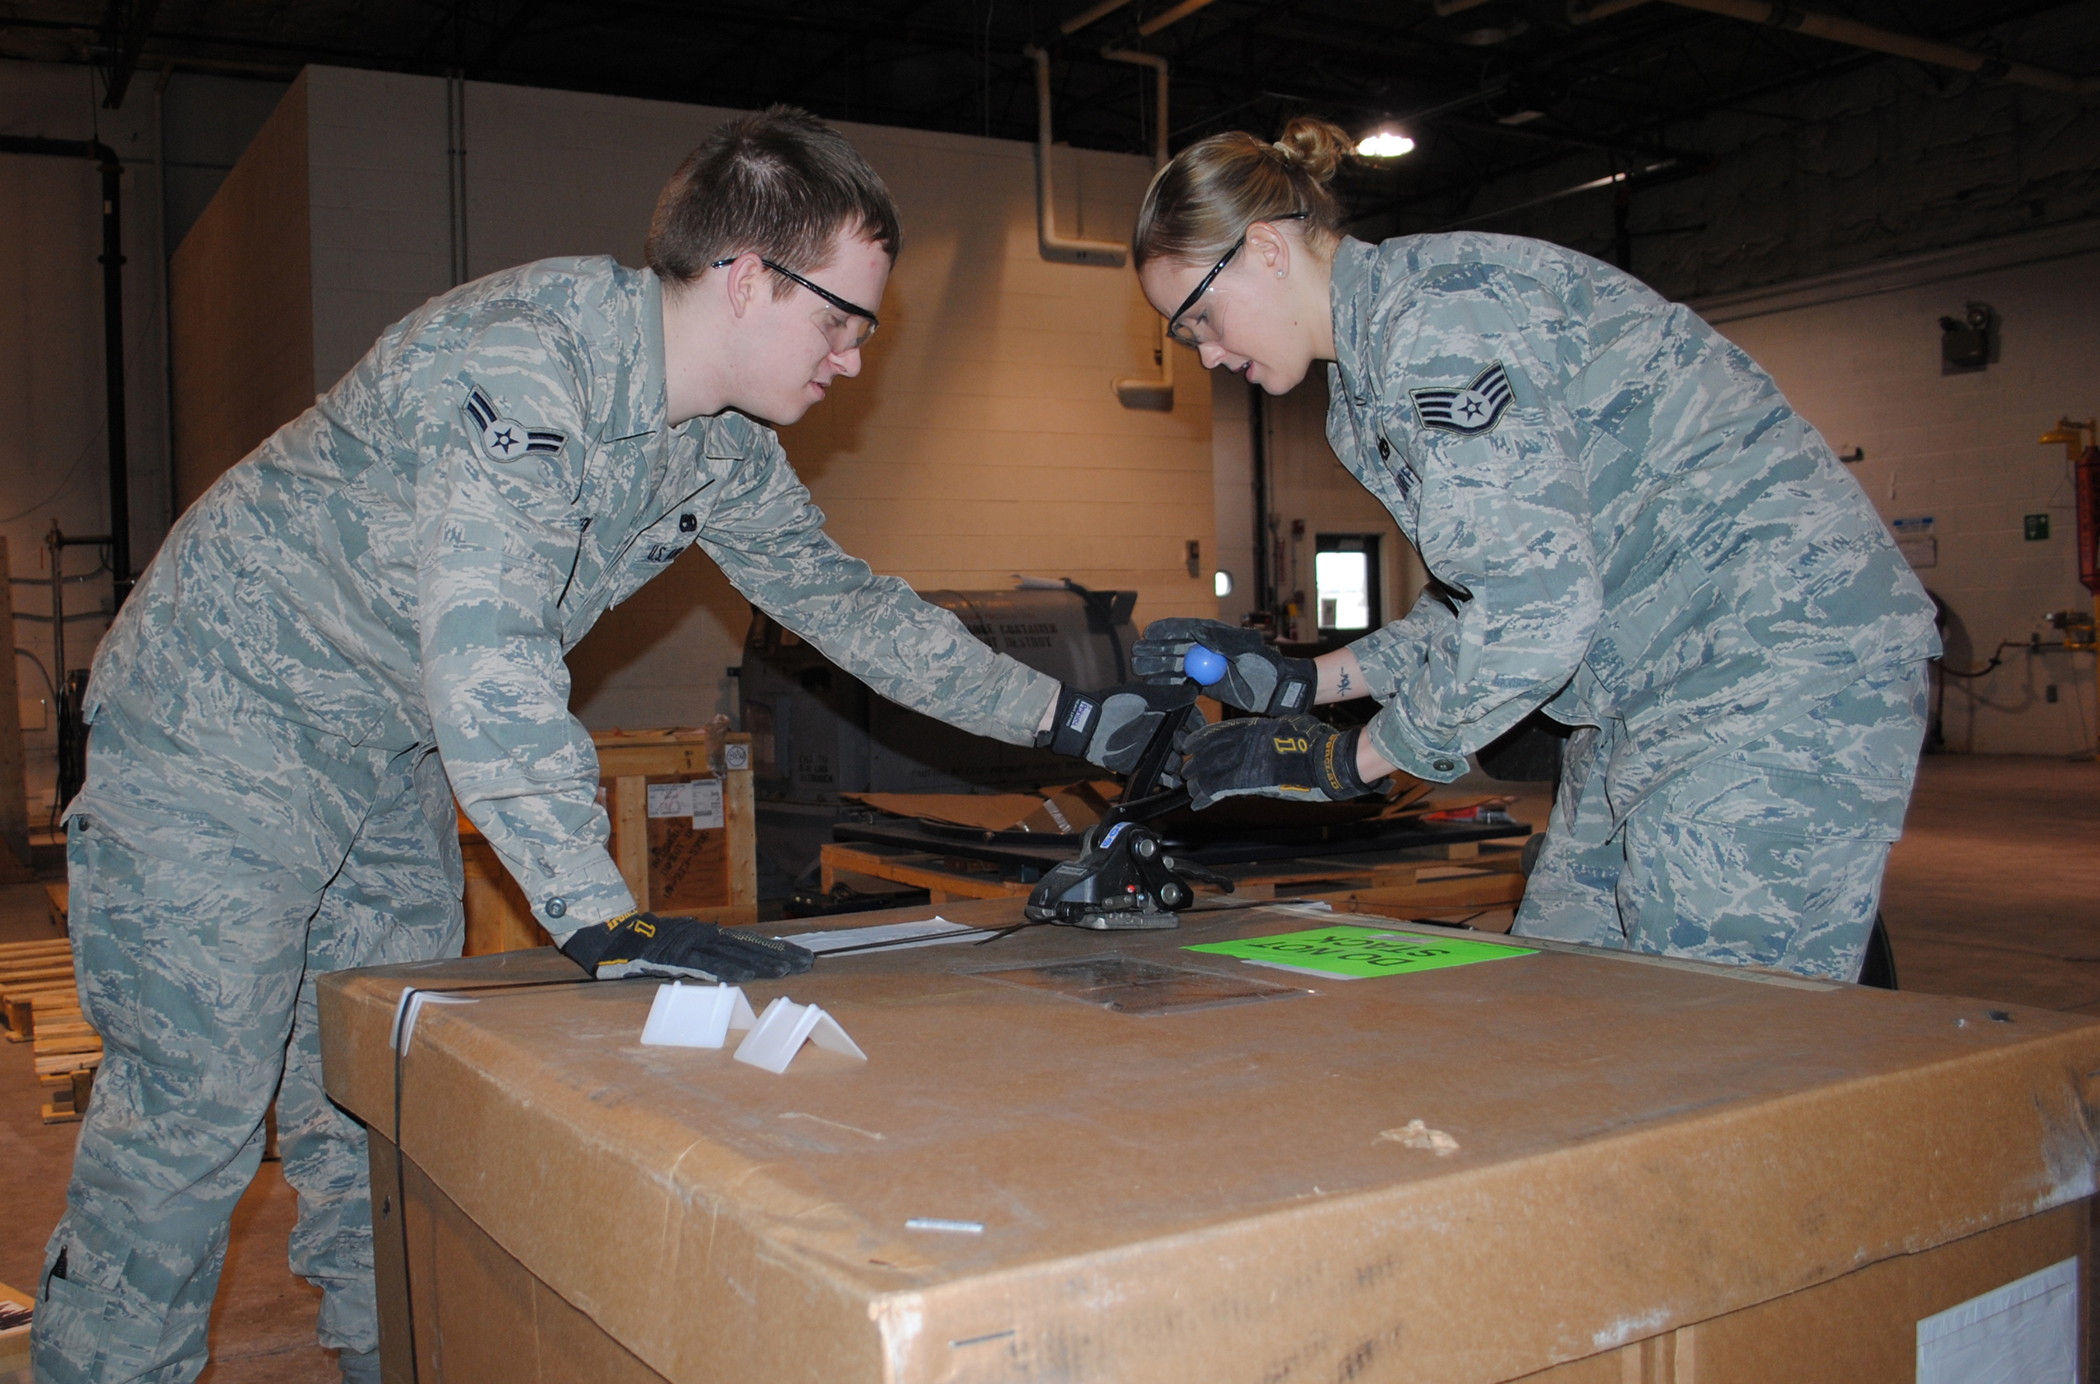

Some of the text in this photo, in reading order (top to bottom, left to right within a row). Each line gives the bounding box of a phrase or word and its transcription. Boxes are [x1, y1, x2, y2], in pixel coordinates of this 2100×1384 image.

[999, 623, 1058, 635] CONTAINER
[1004, 636, 1052, 649] DESTROY
[1247, 940, 1416, 967] DO NOT
[1304, 935, 1451, 957] STACK
